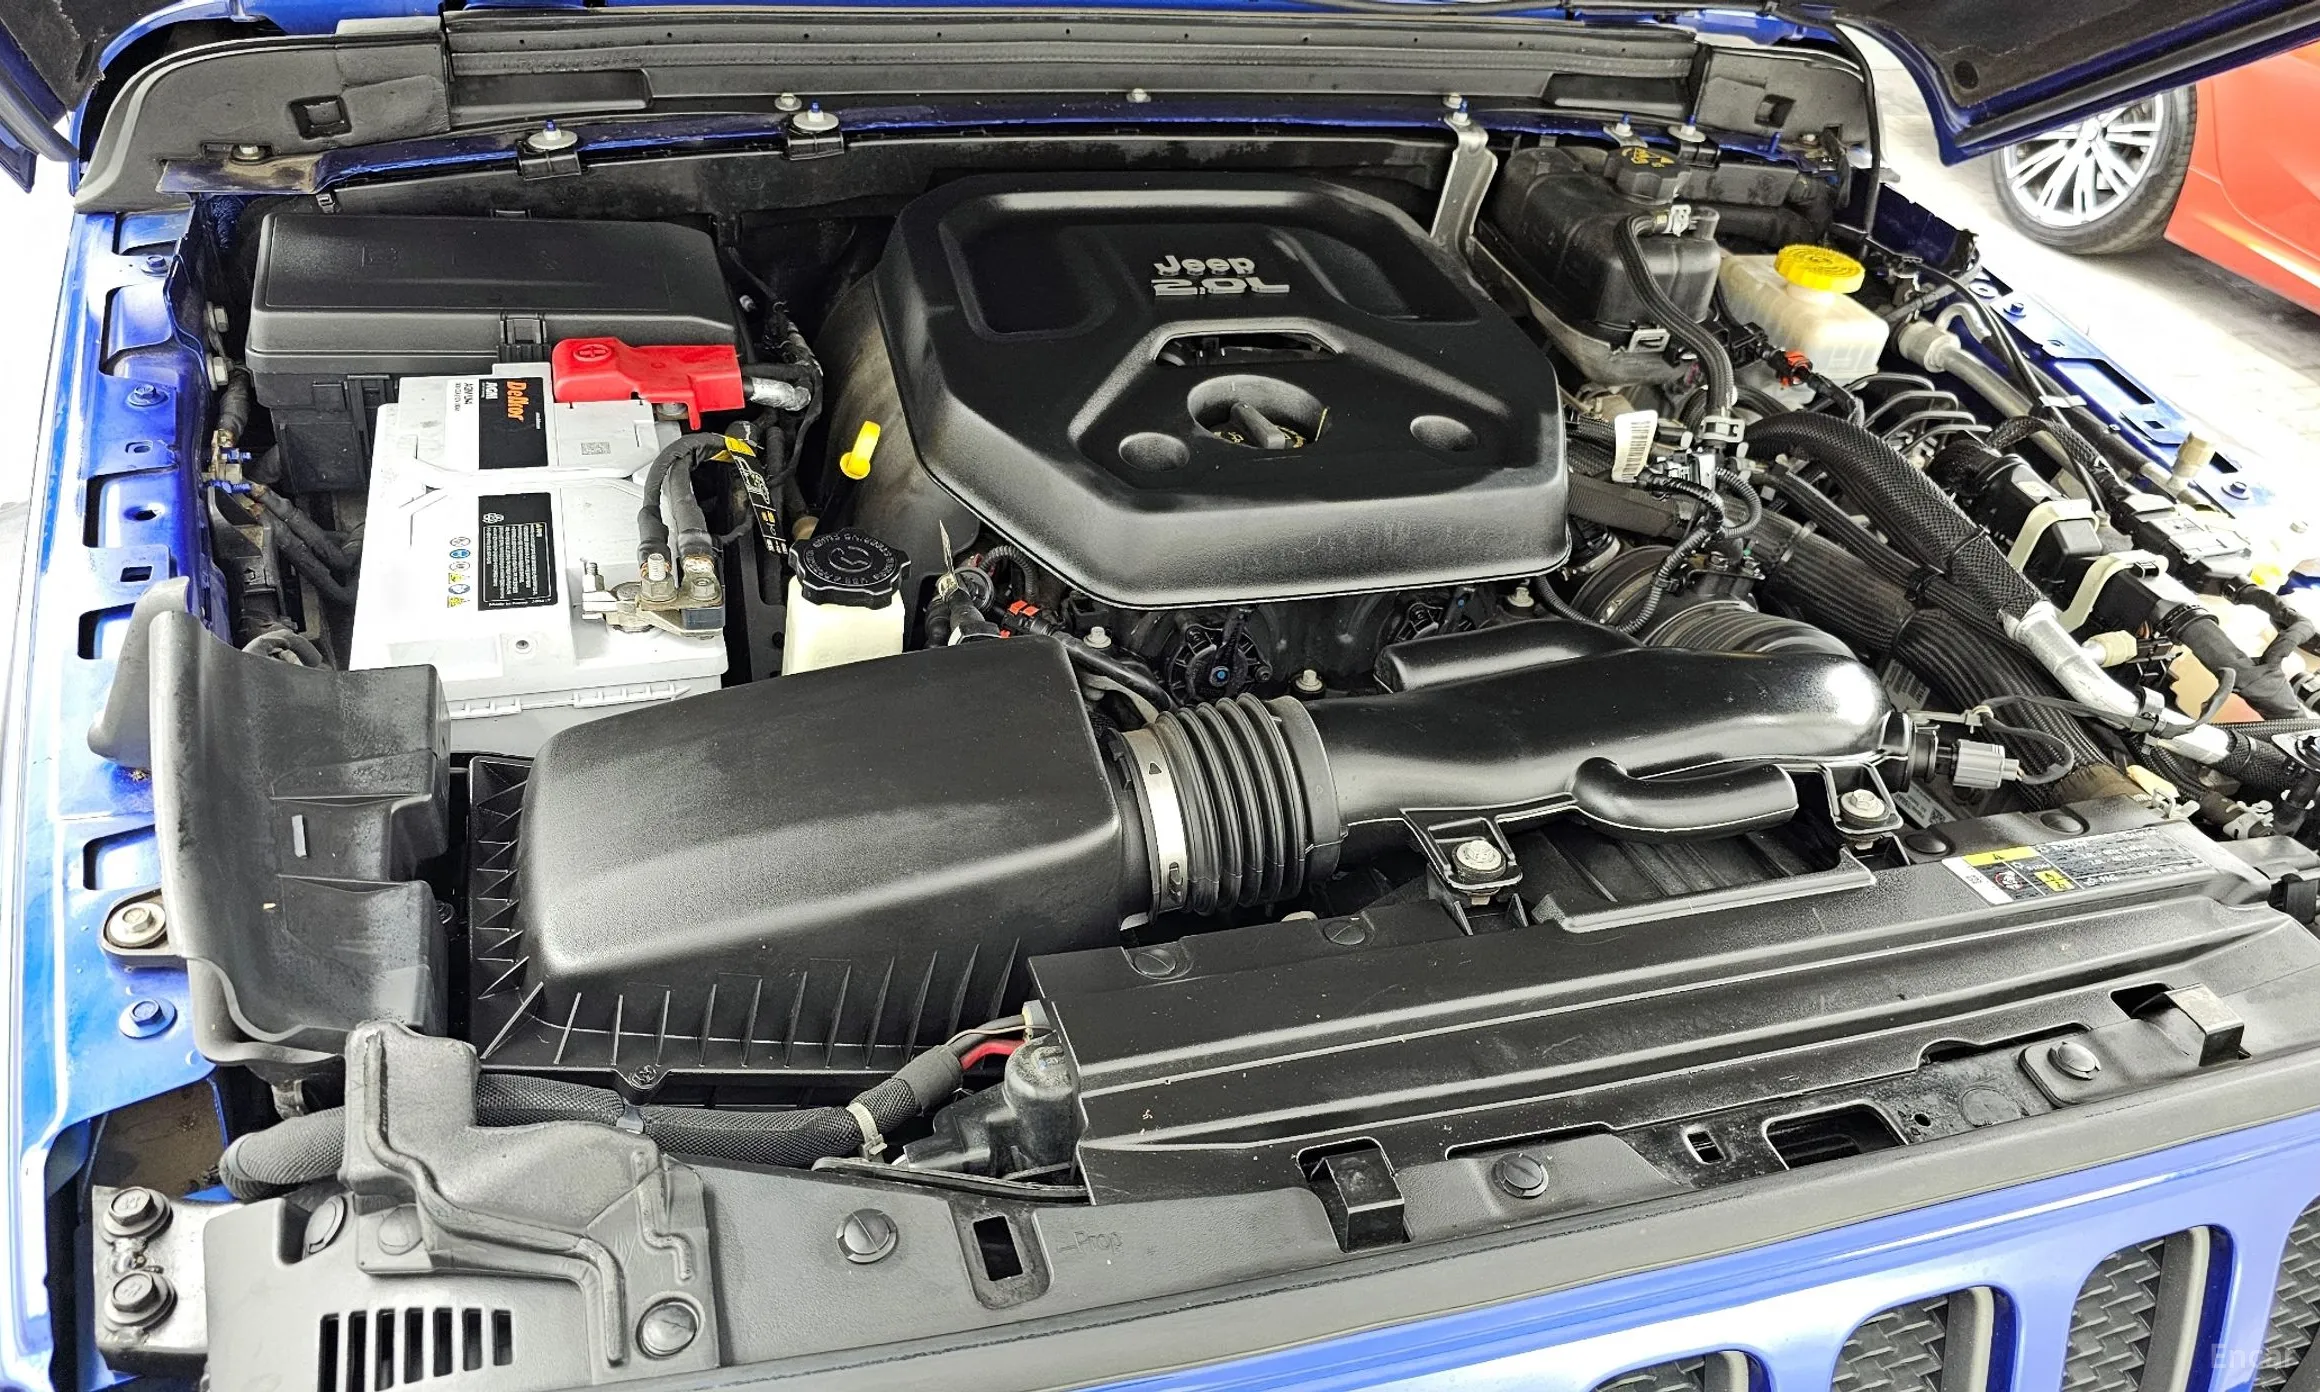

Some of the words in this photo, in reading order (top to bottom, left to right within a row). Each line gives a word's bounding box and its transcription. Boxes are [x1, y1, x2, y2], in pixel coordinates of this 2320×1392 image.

[1153, 254, 1256, 278] Jeep
[1151, 276, 1291, 297] 2.0L
[485, 381, 499, 400] AGM
[506, 381, 530, 423] Delkor
[1073, 1231, 1123, 1255] Prop
